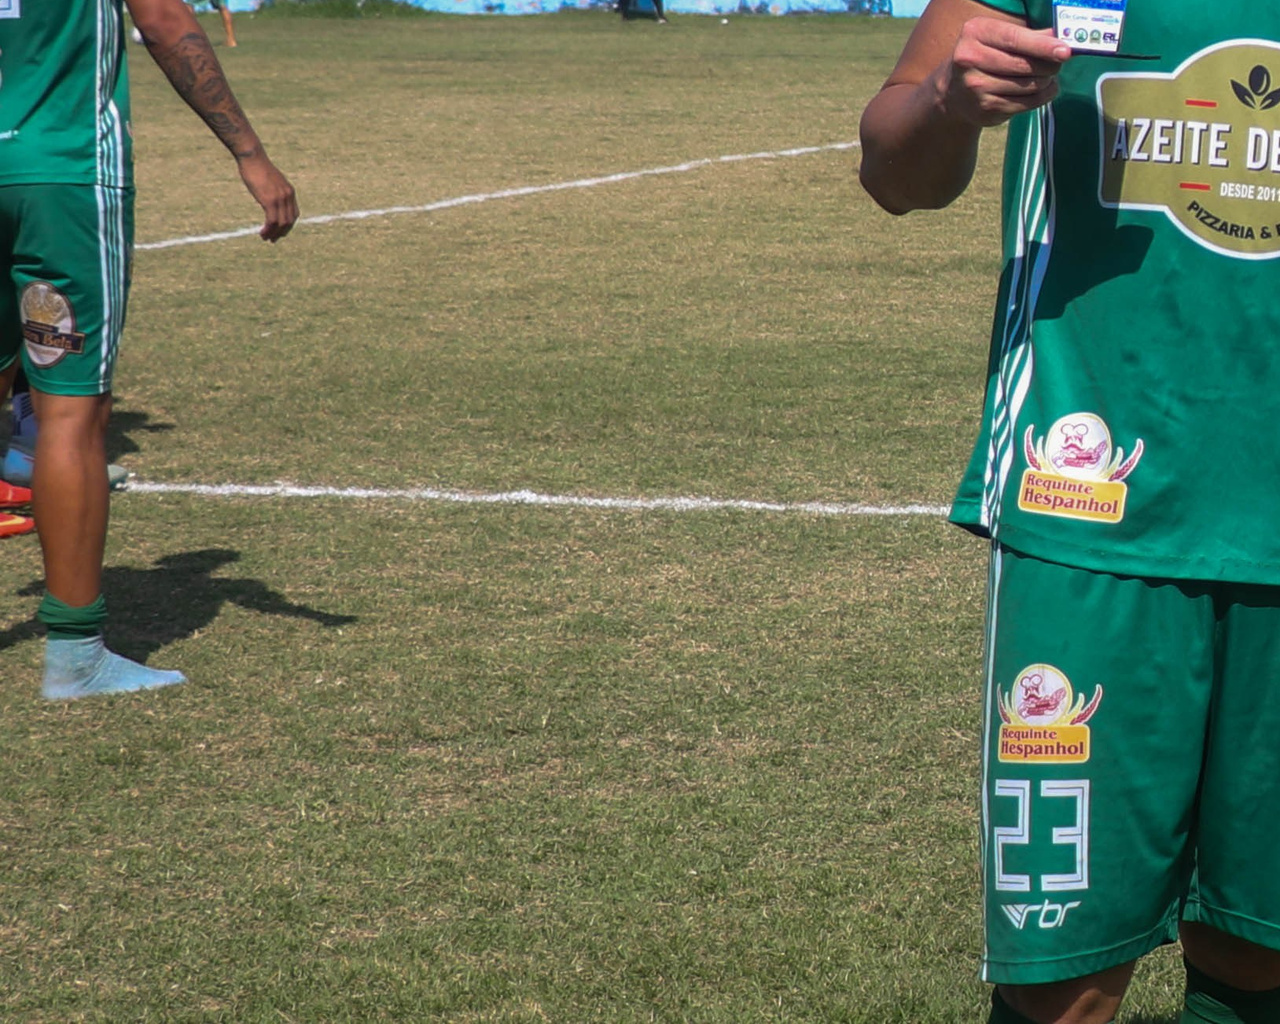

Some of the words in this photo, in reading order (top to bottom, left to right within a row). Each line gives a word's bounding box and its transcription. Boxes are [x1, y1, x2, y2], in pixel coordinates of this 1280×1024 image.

[1112, 117, 1231, 168] AZEITE
[1220, 182, 1255, 199] DESDE
[1187, 200, 1256, 240] PIZZARIA
[1260, 226, 1272, 240] &
[1026, 473, 1094, 495] Requinte
[1023, 487, 1119, 514] Hespanhol
[1002, 727, 1057, 742] Requinte
[1001, 741, 1084, 758] Hespanhol
[994, 778, 1090, 892] 23
